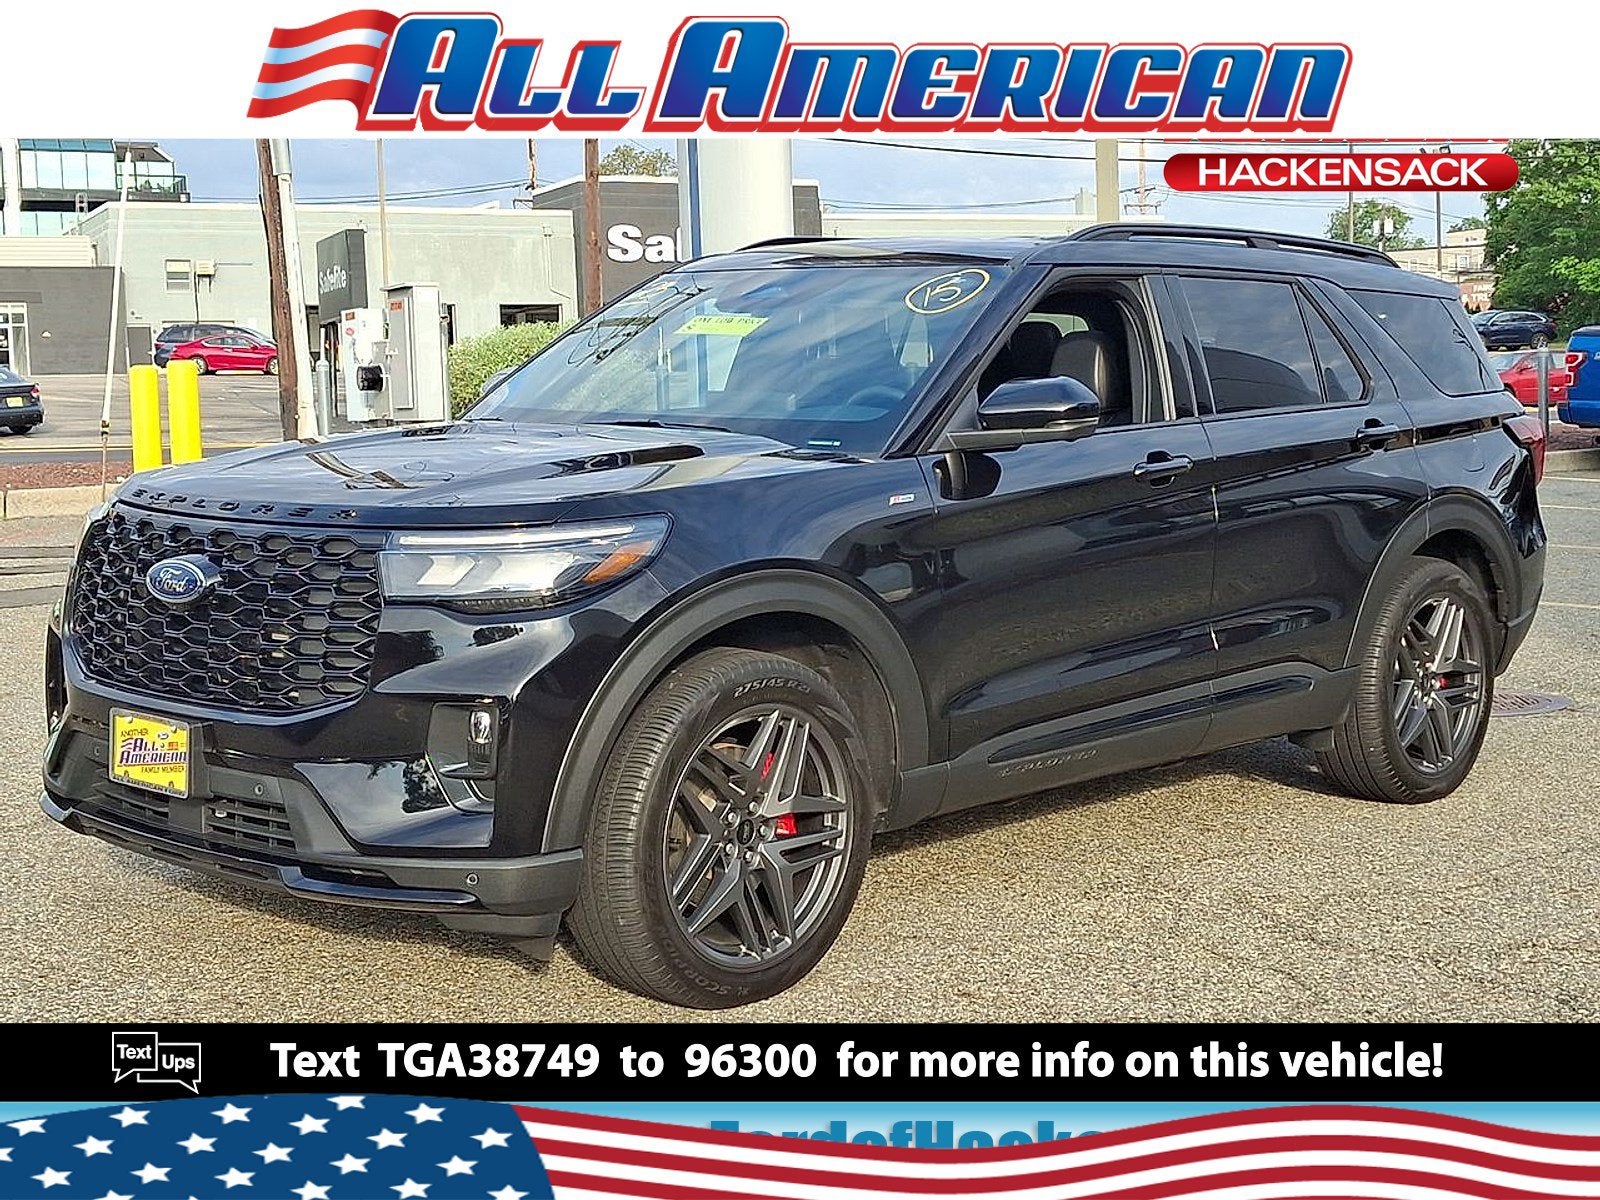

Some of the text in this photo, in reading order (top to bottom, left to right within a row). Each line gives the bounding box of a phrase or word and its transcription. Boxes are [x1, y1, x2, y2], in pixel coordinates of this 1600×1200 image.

[923, 276, 966, 307] 15
[156, 566, 191, 593] Ford
[120, 728, 149, 738] ANOTHER
